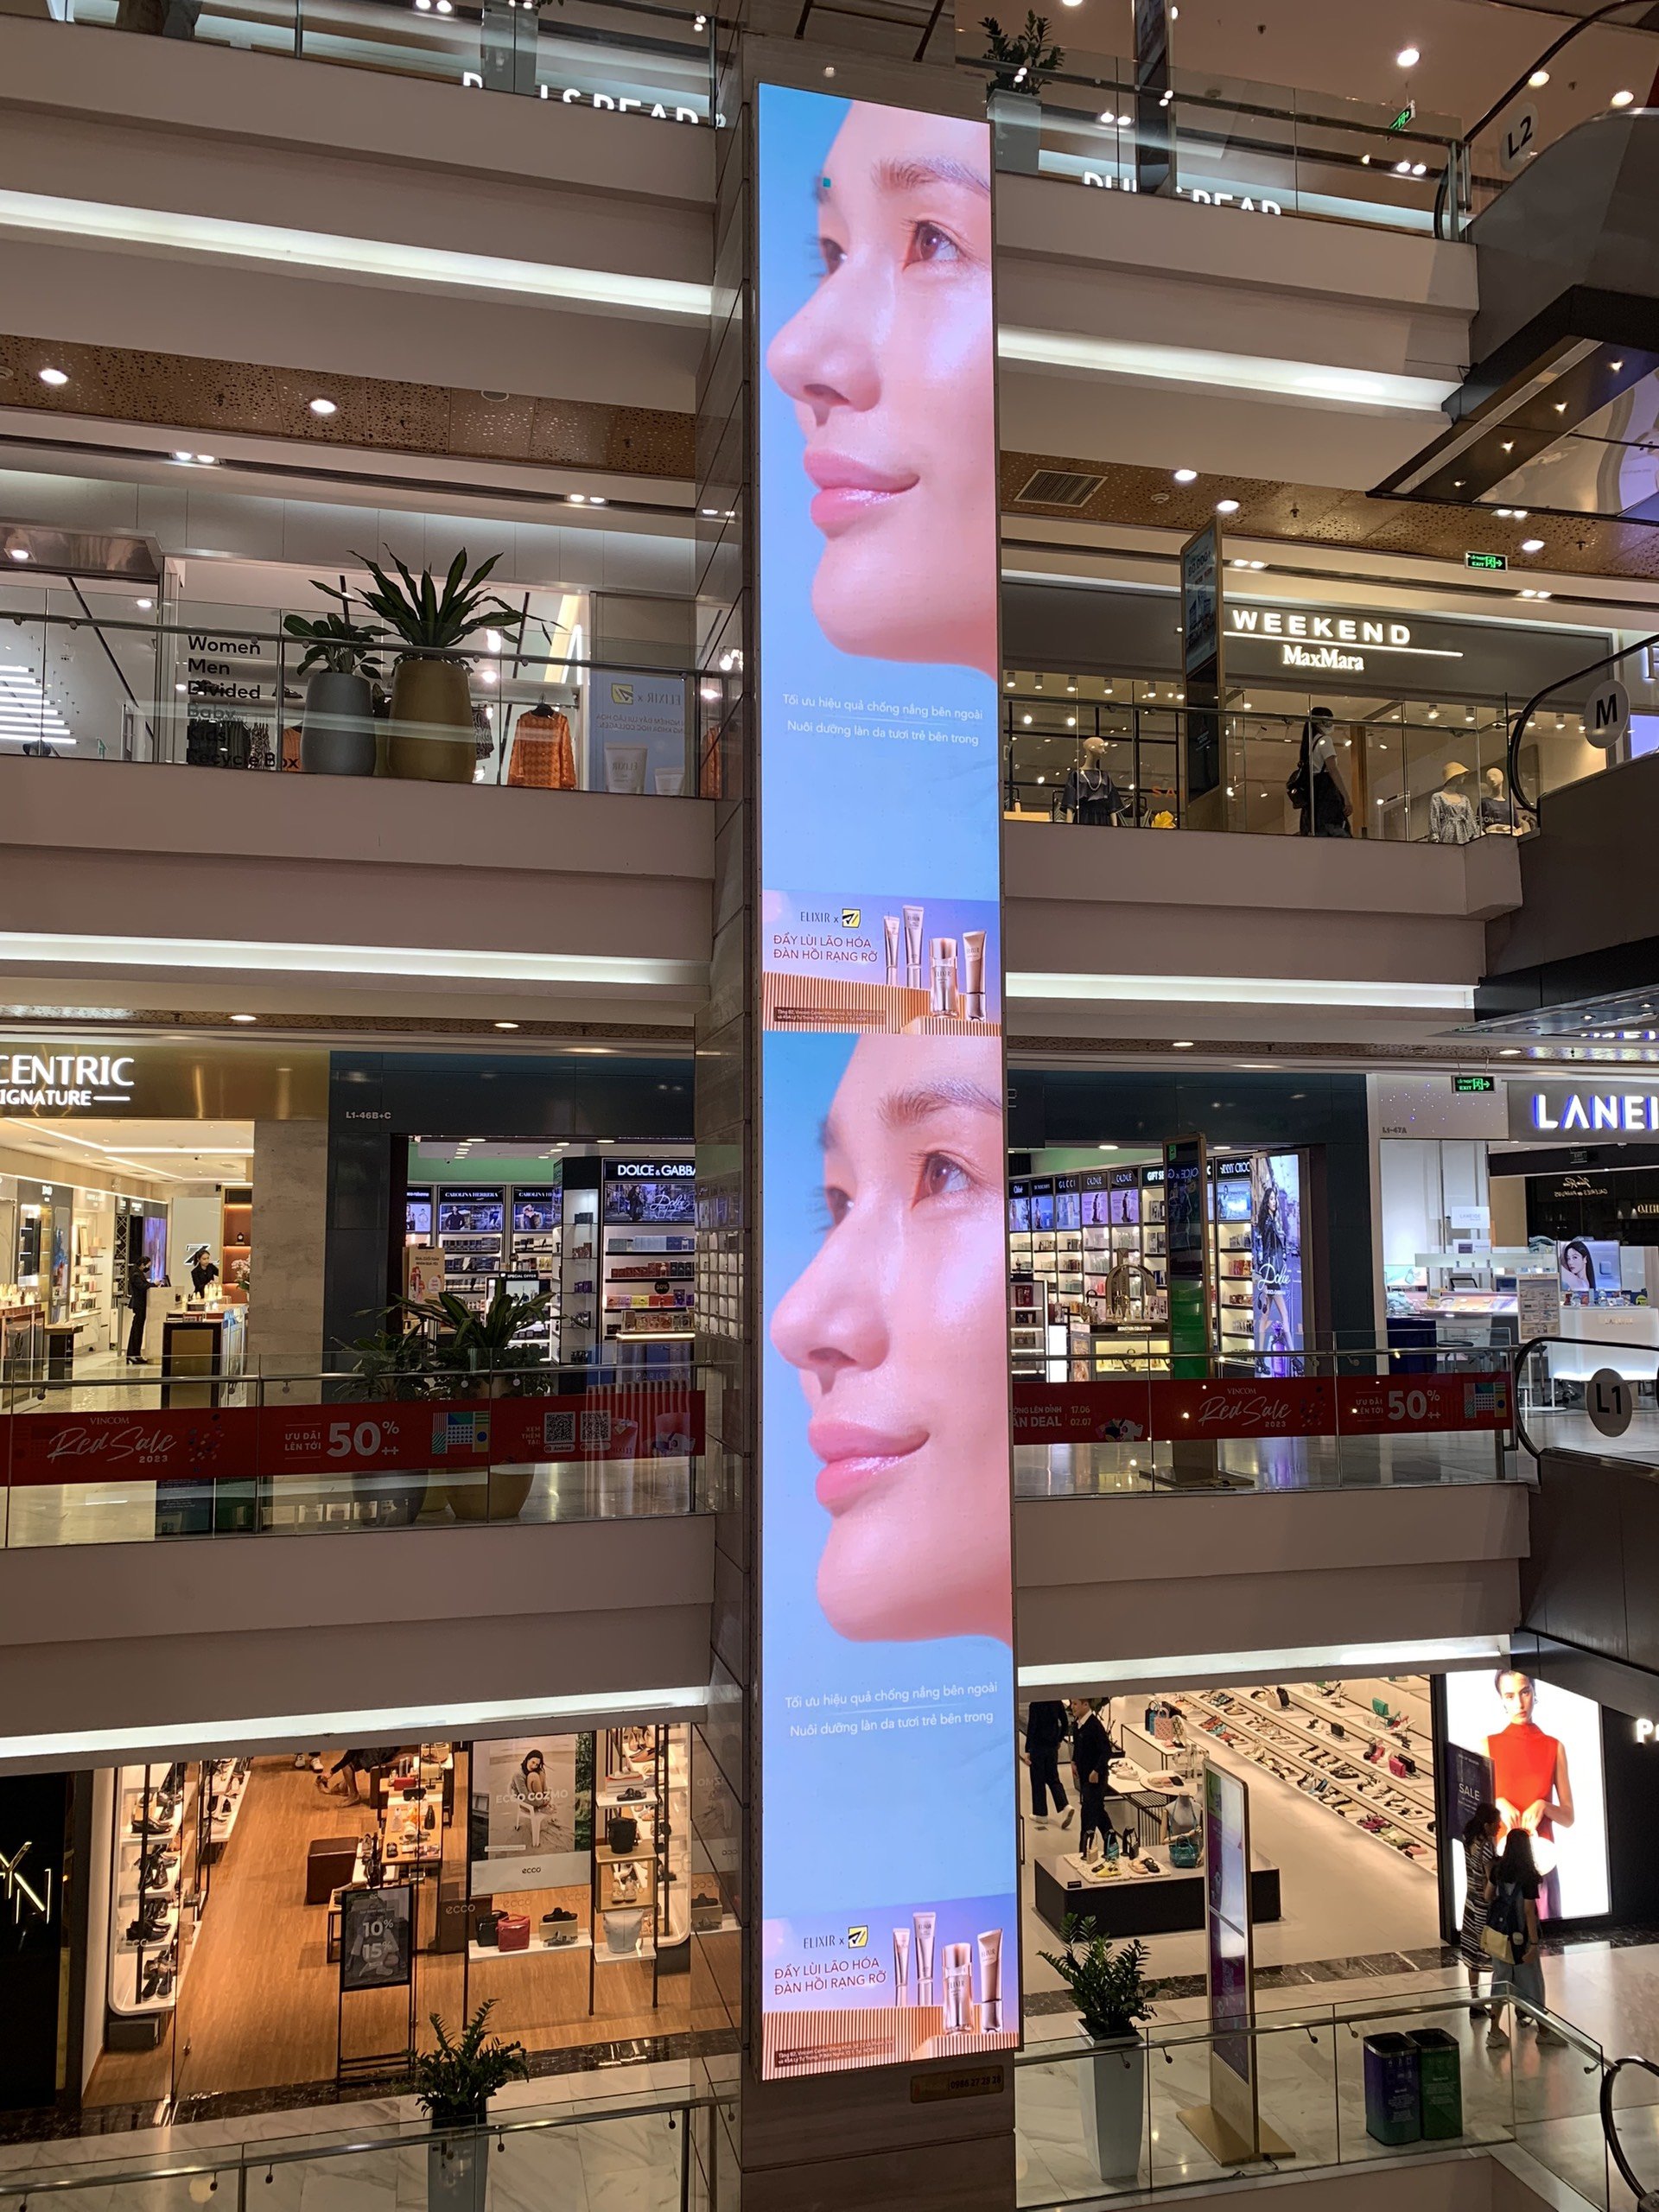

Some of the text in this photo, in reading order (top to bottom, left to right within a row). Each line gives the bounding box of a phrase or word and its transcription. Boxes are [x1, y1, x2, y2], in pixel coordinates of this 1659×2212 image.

[1507, 115, 1534, 160] L2
[1232, 609, 1411, 645] WEEKEND
[188, 635, 261, 655] Women
[188, 658, 231, 675] Men
[1282, 645, 1365, 671] MaxMara
[188, 680, 261, 700] Divided
[187, 702, 237, 721] Baby
[782, 693, 983, 721] Tối ưu hiệu quả chống nắng bên ngoài
[1595, 692, 1618, 729] M
[787, 720, 979, 747] Nuôi dưỡng làn da tươi trẻ bên trong
[800, 911, 830, 924] ELIXIR
[773, 931, 872, 949] ĐẨY LÙI LÃO HÓA
[773, 946, 879, 964] ĐÀN HỒI RẠNG RỠ
[617, 1164, 654, 1176] DOLCE
[1147, 1171, 1158, 1180] GIFT
[1058, 1179, 1076, 1189] GUCCI
[1595, 1382, 1622, 1414] L1
[1030, 1404, 1044, 1414] LÊN
[1071, 1405, 1090, 1414] 17.06
[1198, 1395, 1293, 1427] Red Sale
[90, 1416, 130, 1425] VINCOM
[1031, 1415, 1063, 1427] DEAL
[47, 1426, 177, 1464] Red Sale
[285, 1432, 301, 1441] ƯU
[284, 1441, 302, 1452] LÊN
[138, 1454, 168, 1464] 2023
[785, 1681, 998, 1708] Tối ưu hiệu quả chống nắng bên ngoài
[790, 1712, 994, 1737] Nuôi dưỡng làn da tươi trẻ bên trong
[496, 1789, 569, 1803] ECCO COZMO
[1459, 1783, 1480, 1802] SALE
[445, 1904, 475, 1915] ecco
[363, 1919, 394, 1938] 10%
[363, 1941, 392, 1960] 15%
[803, 1934, 836, 1949] ELIXIR
[774, 1956, 880, 1980] ĐẨY LÙI LÃO HÓA
[774, 1970, 887, 1995] ĐÀN HỒI RẠNG RỠ
